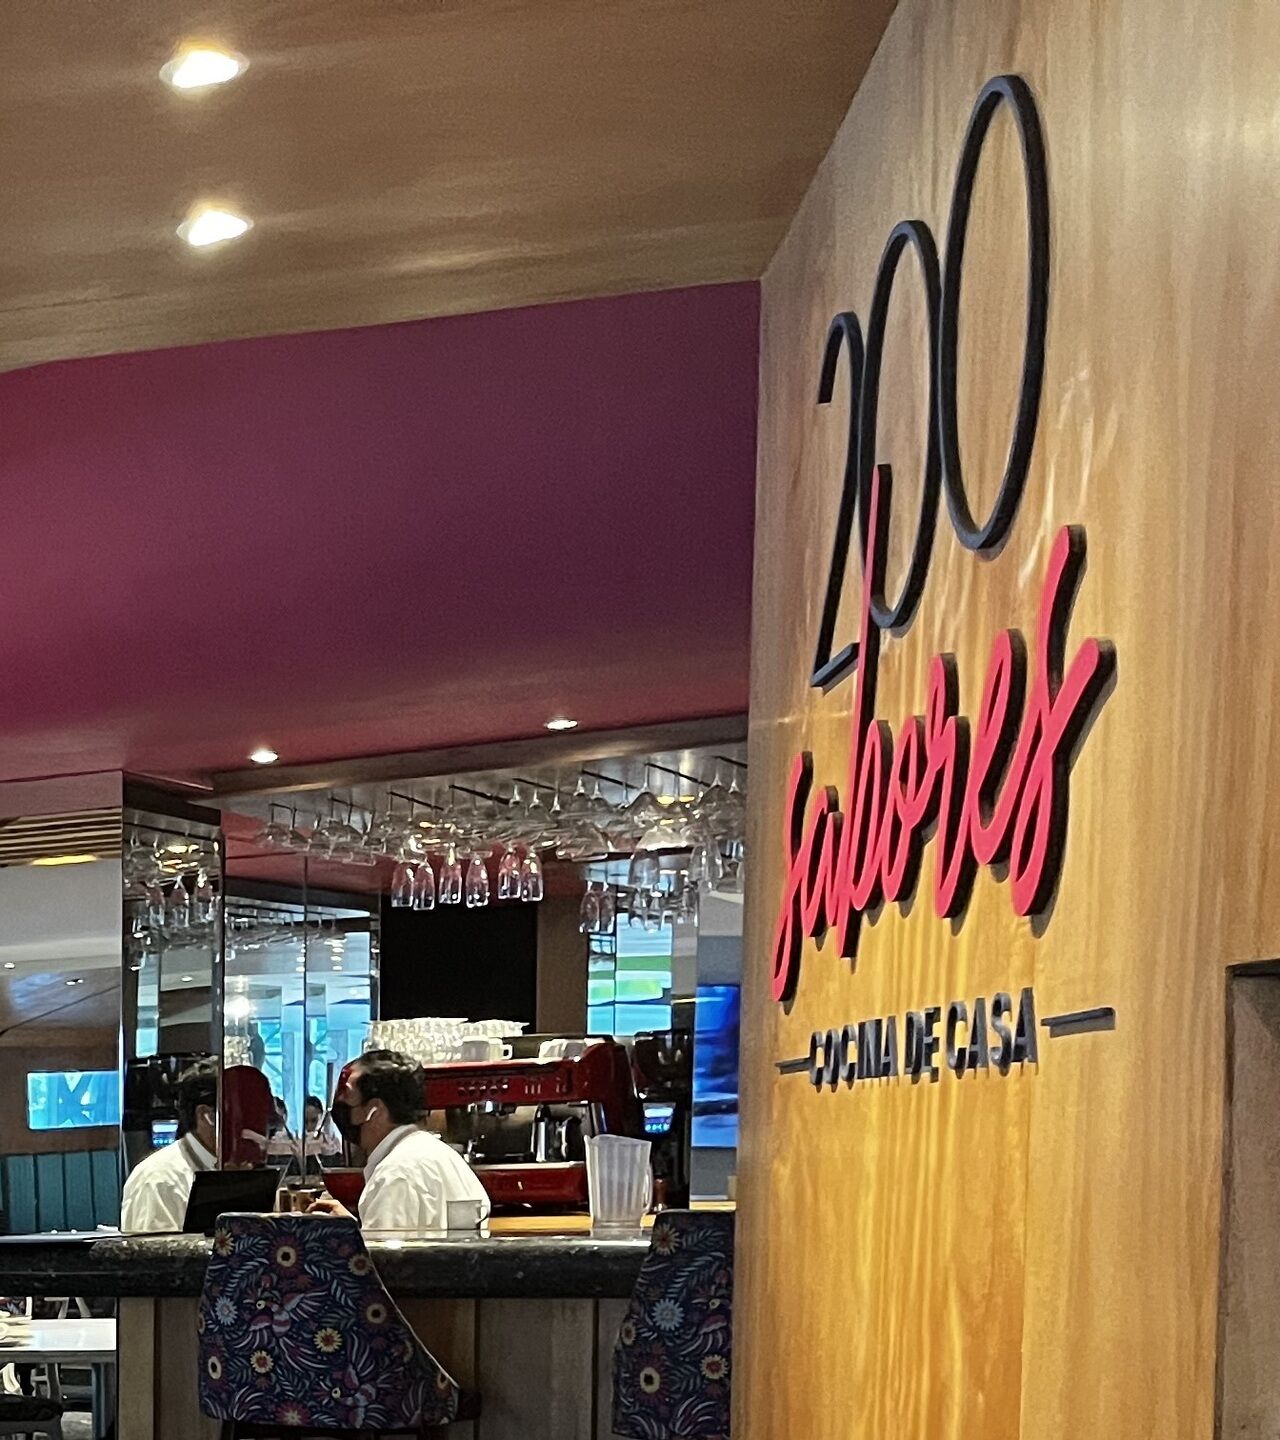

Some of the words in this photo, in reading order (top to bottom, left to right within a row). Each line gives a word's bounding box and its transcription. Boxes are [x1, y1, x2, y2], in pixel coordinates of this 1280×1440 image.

[812, 73, 1052, 688] 200
[809, 1015, 899, 1087] COCINA
[904, 1006, 942, 1085] DE
[946, 987, 1039, 1076] CASA
